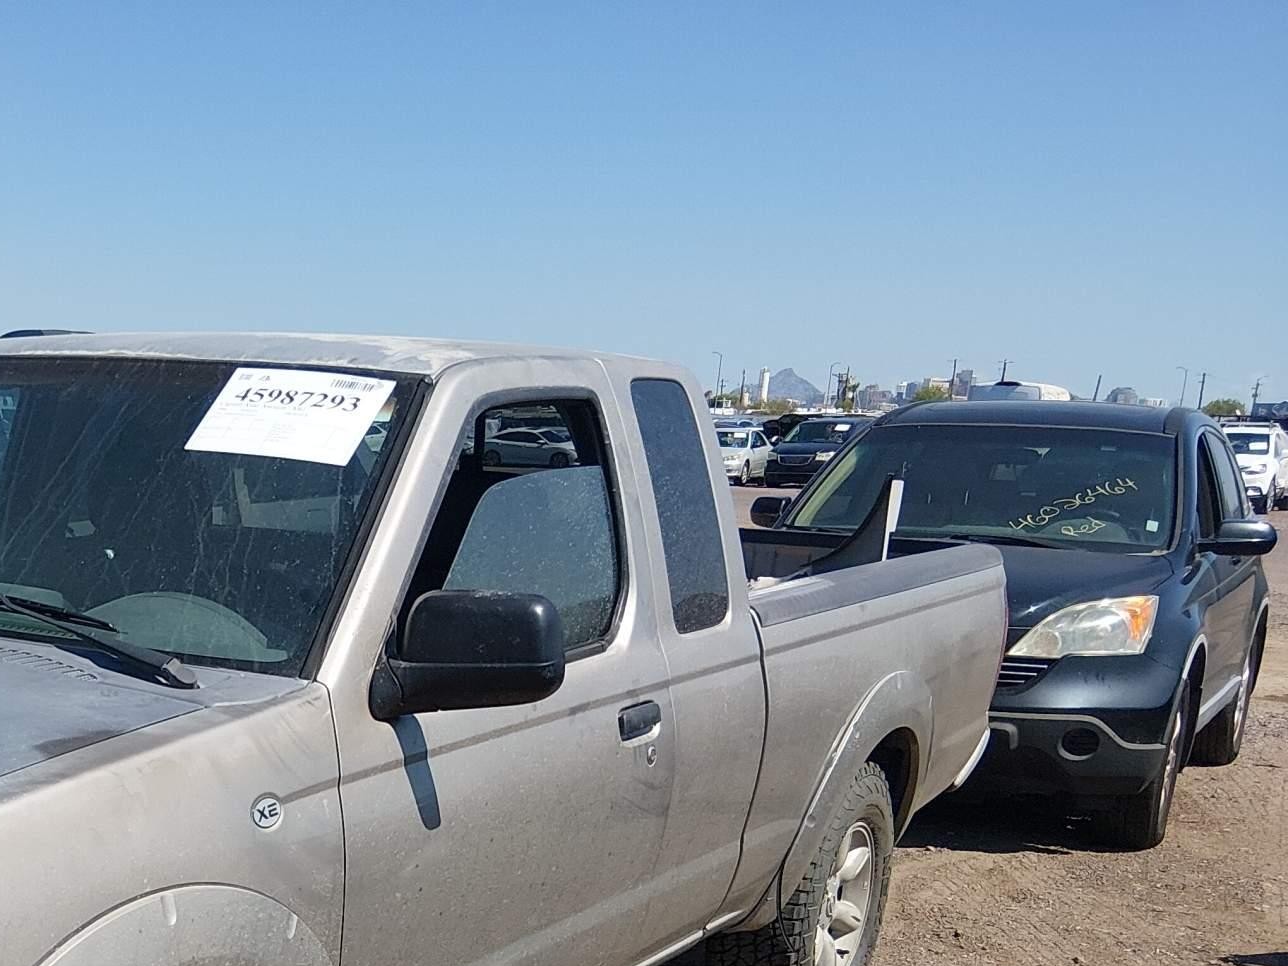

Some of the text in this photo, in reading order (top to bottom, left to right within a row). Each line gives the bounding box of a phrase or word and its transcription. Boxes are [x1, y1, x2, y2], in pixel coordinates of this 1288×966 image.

[235, 387, 361, 413] 45987293
[1008, 477, 1139, 530] 46026464
[256, 802, 279, 823] XE
